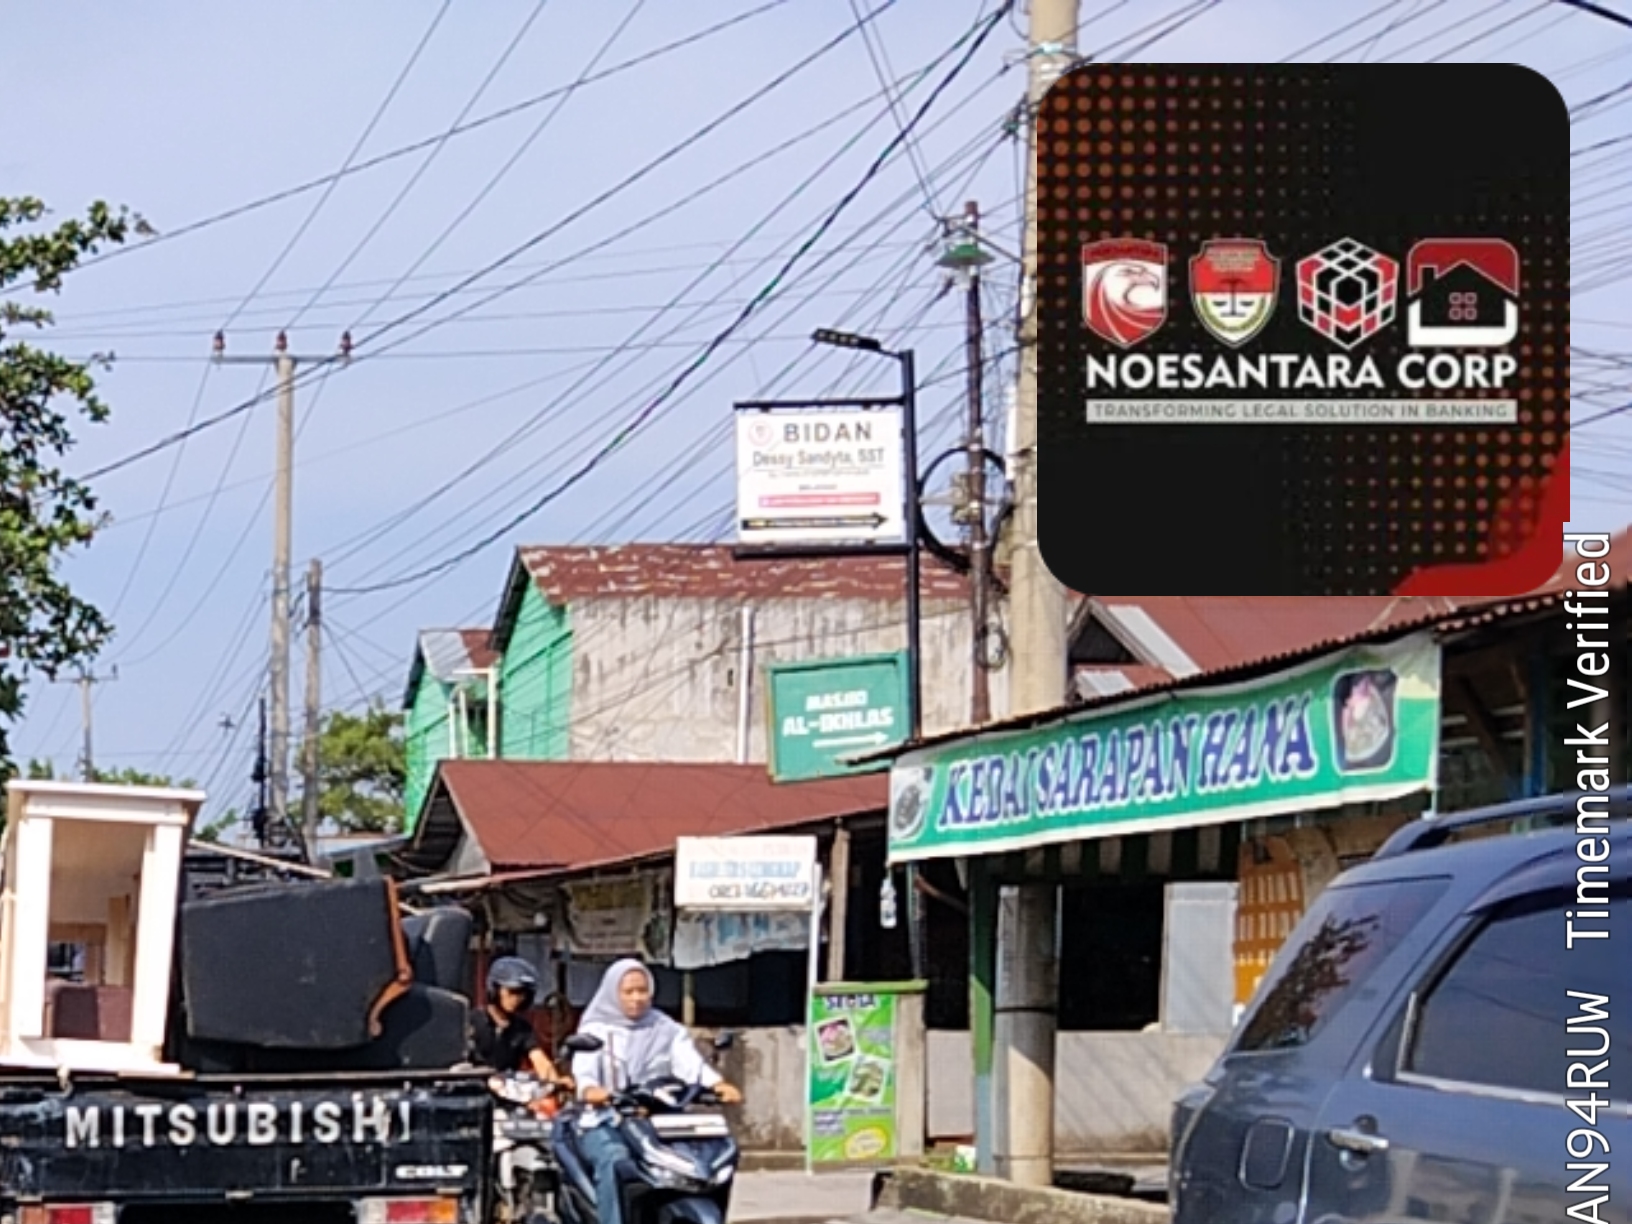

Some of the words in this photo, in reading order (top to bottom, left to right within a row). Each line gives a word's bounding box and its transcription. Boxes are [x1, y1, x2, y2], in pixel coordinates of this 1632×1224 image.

[783, 421, 872, 443] BIDAN
[782, 706, 894, 736] AL-IKHLAS
[939, 750, 1036, 829] KEDAI
[1036, 714, 1197, 816] SARAPAN
[1197, 697, 1316, 789] HANA
[66, 1098, 411, 1148] MITSUBISHI
[395, 1164, 468, 1180] COLT
